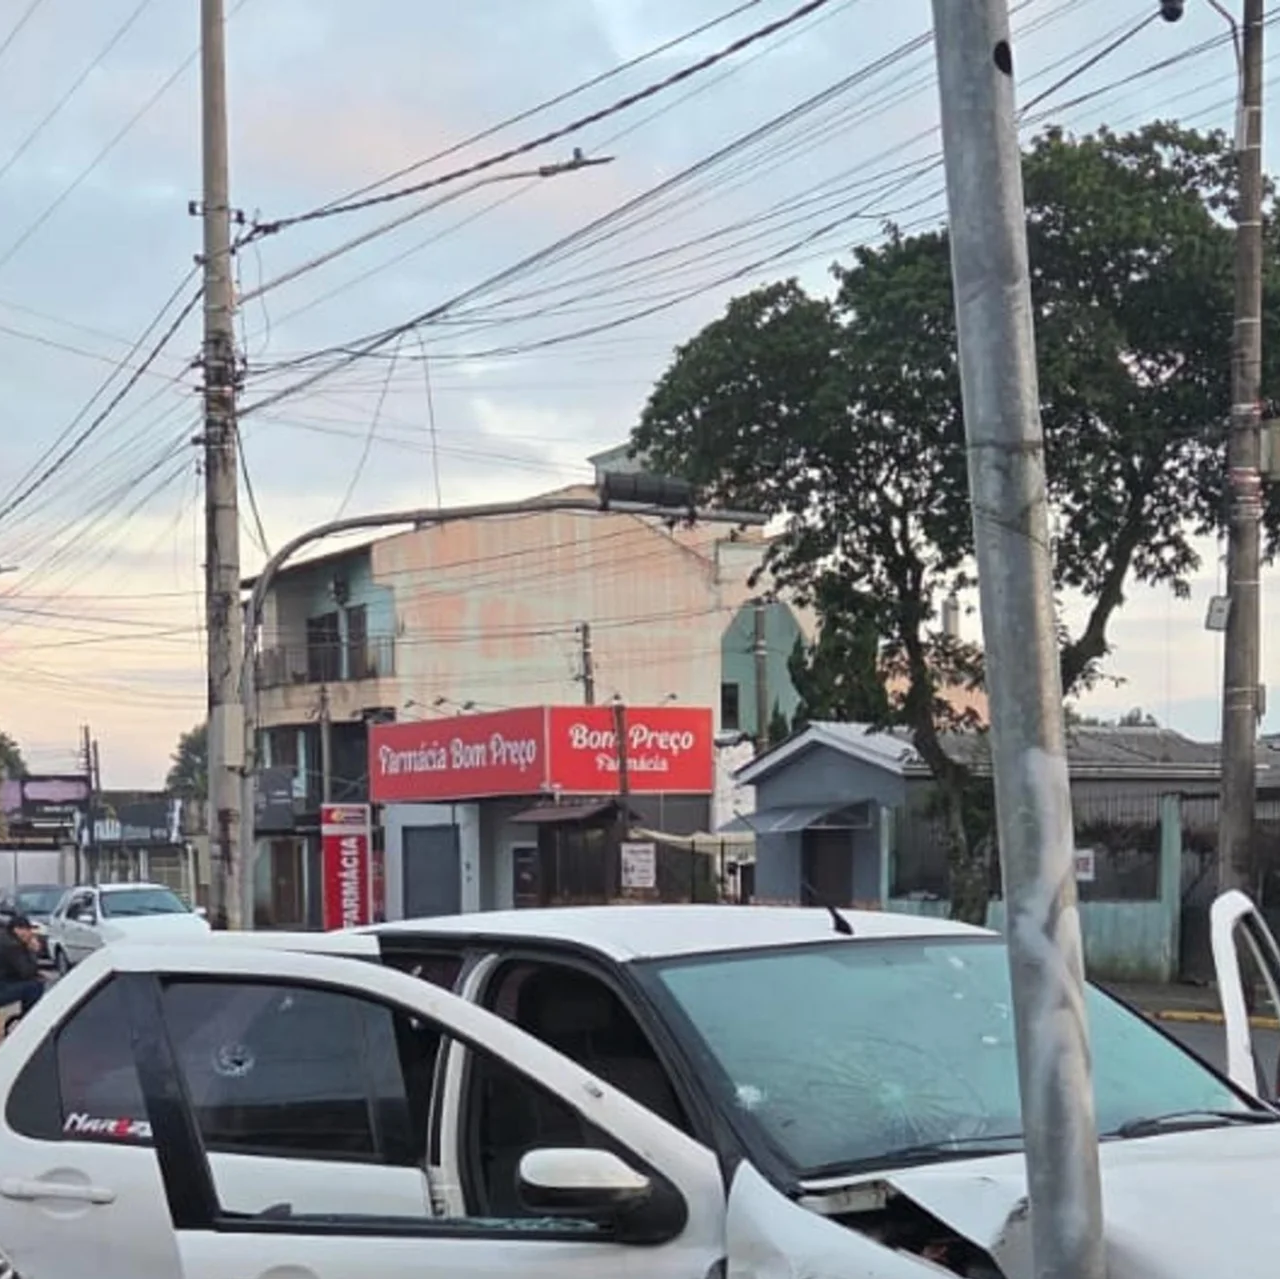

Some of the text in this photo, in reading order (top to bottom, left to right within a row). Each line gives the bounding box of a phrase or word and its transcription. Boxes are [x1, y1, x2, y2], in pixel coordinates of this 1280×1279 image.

[379, 732, 538, 775] Farmácia Bom Preço
[628, 724, 694, 758] Preço
